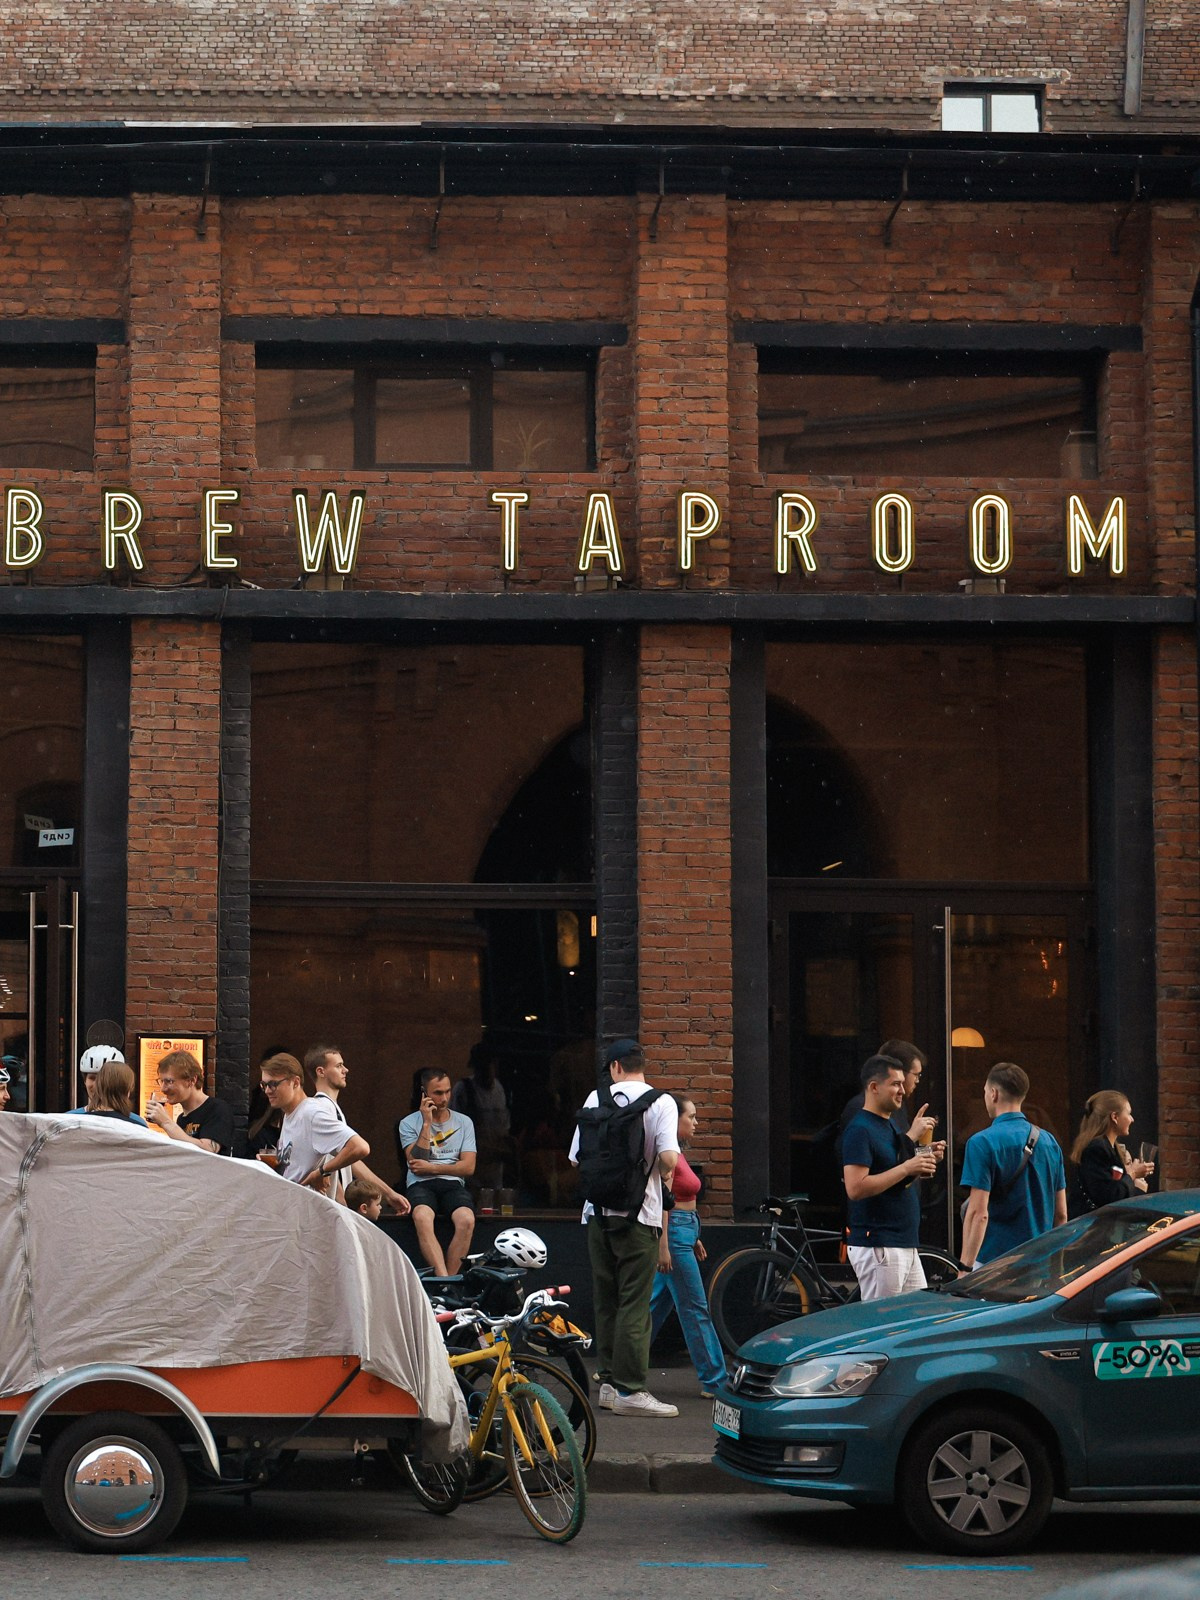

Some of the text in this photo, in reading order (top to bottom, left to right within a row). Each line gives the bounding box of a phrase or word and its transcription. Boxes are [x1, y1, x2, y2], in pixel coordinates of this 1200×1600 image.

[4, 485, 366, 574] BREW
[487, 489, 1128, 577] TAPROOM
[1099, 1344, 1180, 1369] -50%
